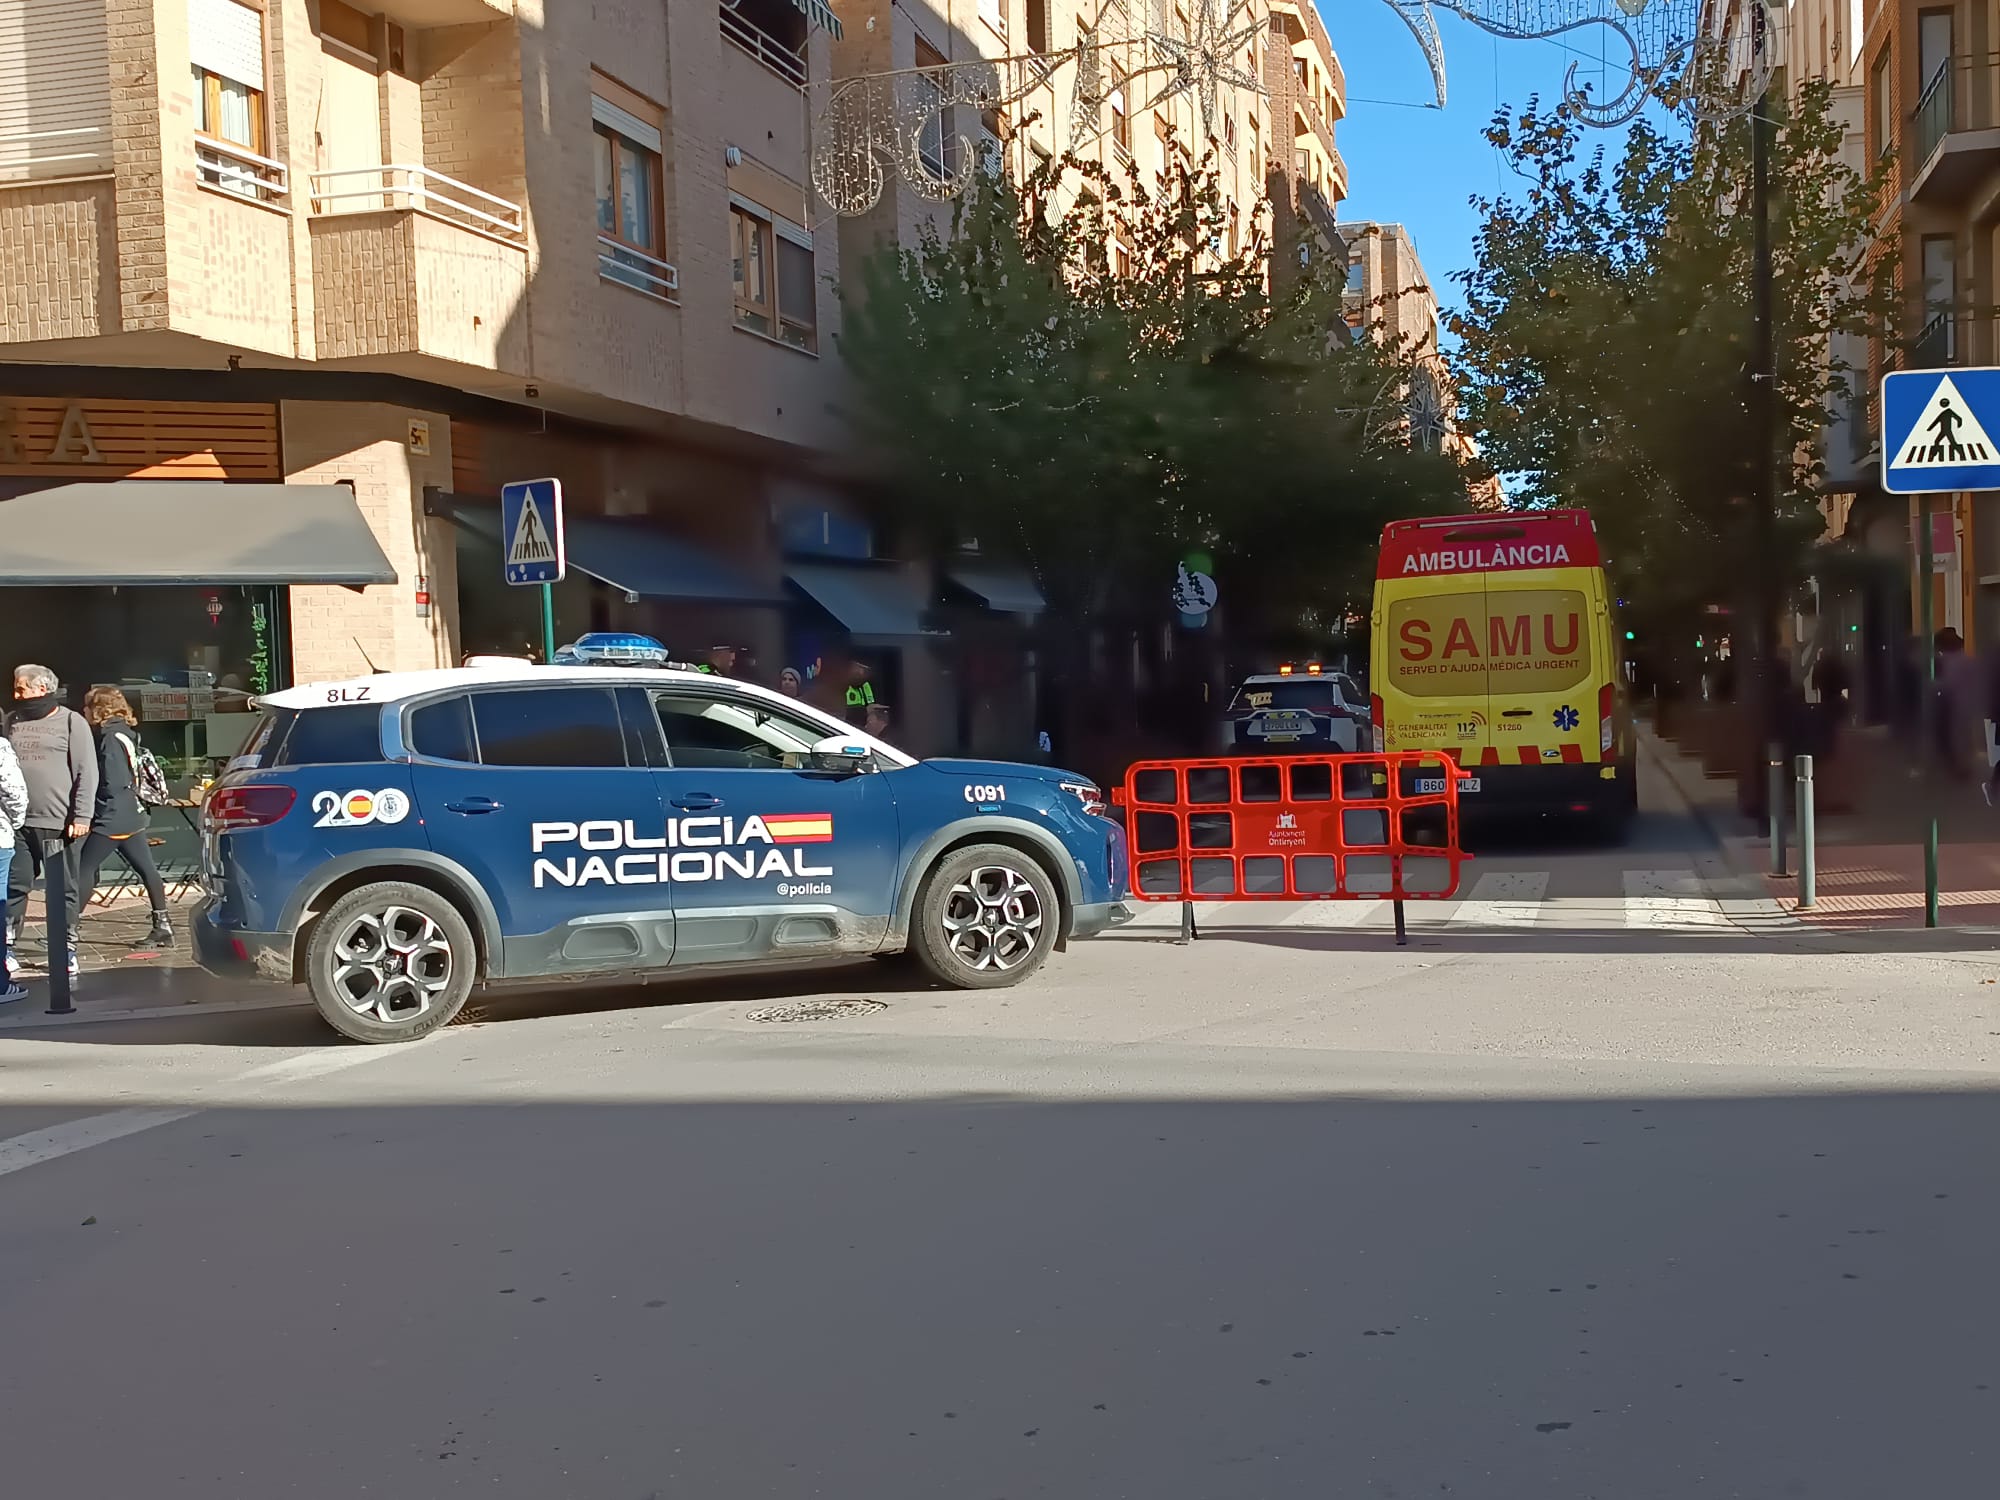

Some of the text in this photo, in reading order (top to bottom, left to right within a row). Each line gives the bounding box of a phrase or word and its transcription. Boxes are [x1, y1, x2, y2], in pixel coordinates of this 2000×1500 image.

[1403, 544, 1570, 573] AMBULÀNCIA
[1400, 613, 1579, 661] SAMU
[1399, 665, 1437, 675] SERVEI
[1534, 659, 1580, 670] URGENT
[327, 687, 371, 703] 8LZ
[1398, 723, 1447, 731] GENERALITAT
[1457, 723, 1475, 733] 112
[312, 787, 410, 828] 200
[533, 848, 833, 889] NACIONAL
[776, 882, 832, 898] @policia
